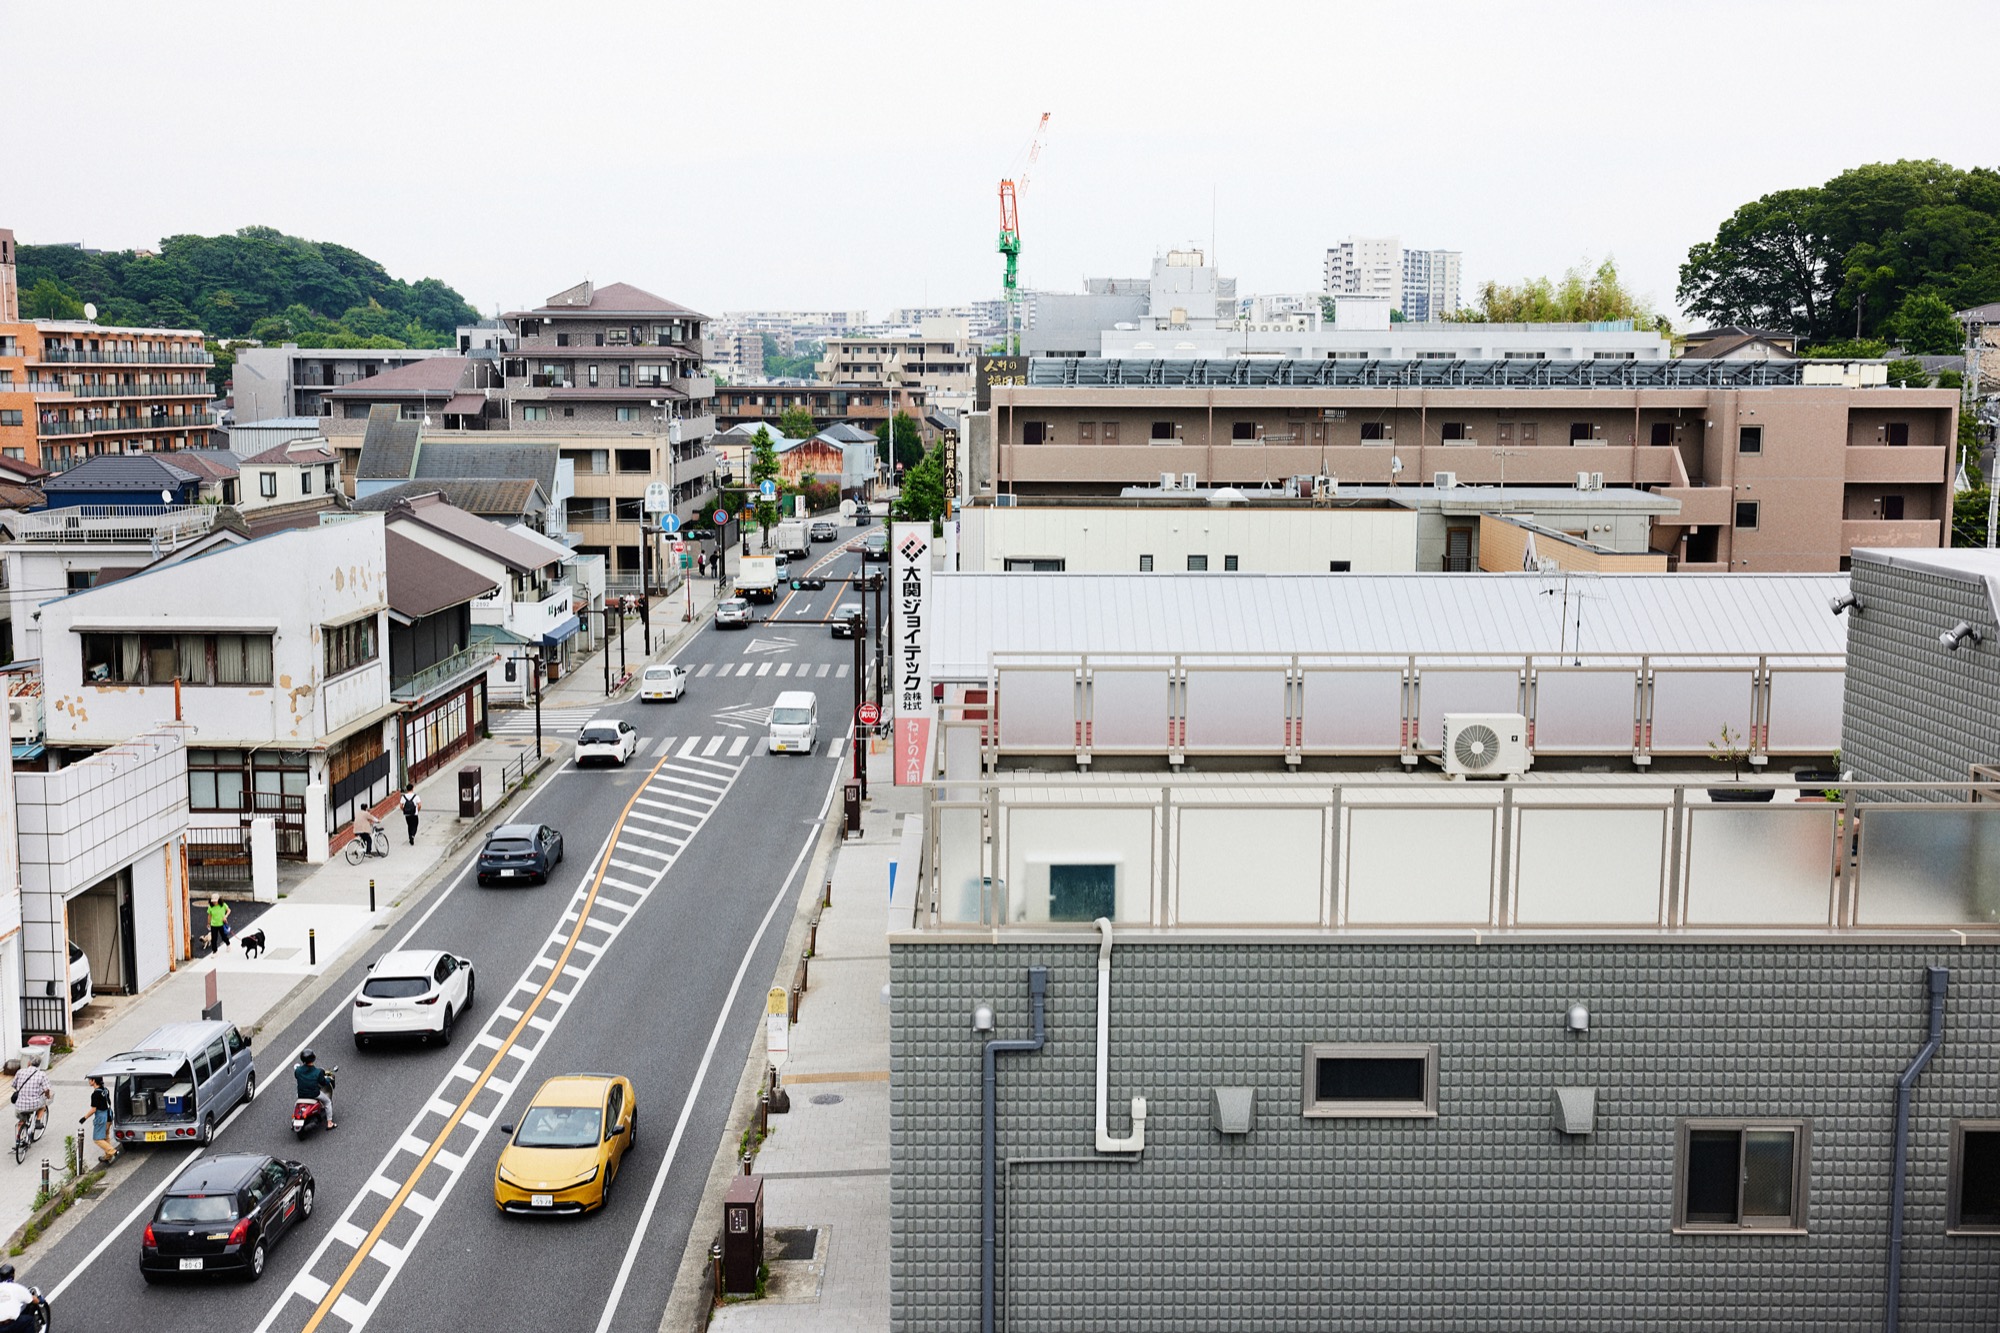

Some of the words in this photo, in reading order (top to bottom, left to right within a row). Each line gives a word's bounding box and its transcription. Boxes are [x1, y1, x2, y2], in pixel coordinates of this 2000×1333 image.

[983, 359, 1017, 372] 人形の
[945, 440, 955, 497] 福田屋人形店
[902, 566, 922, 691] 大関ジョイテック
[906, 719, 921, 783] ねじの大関
